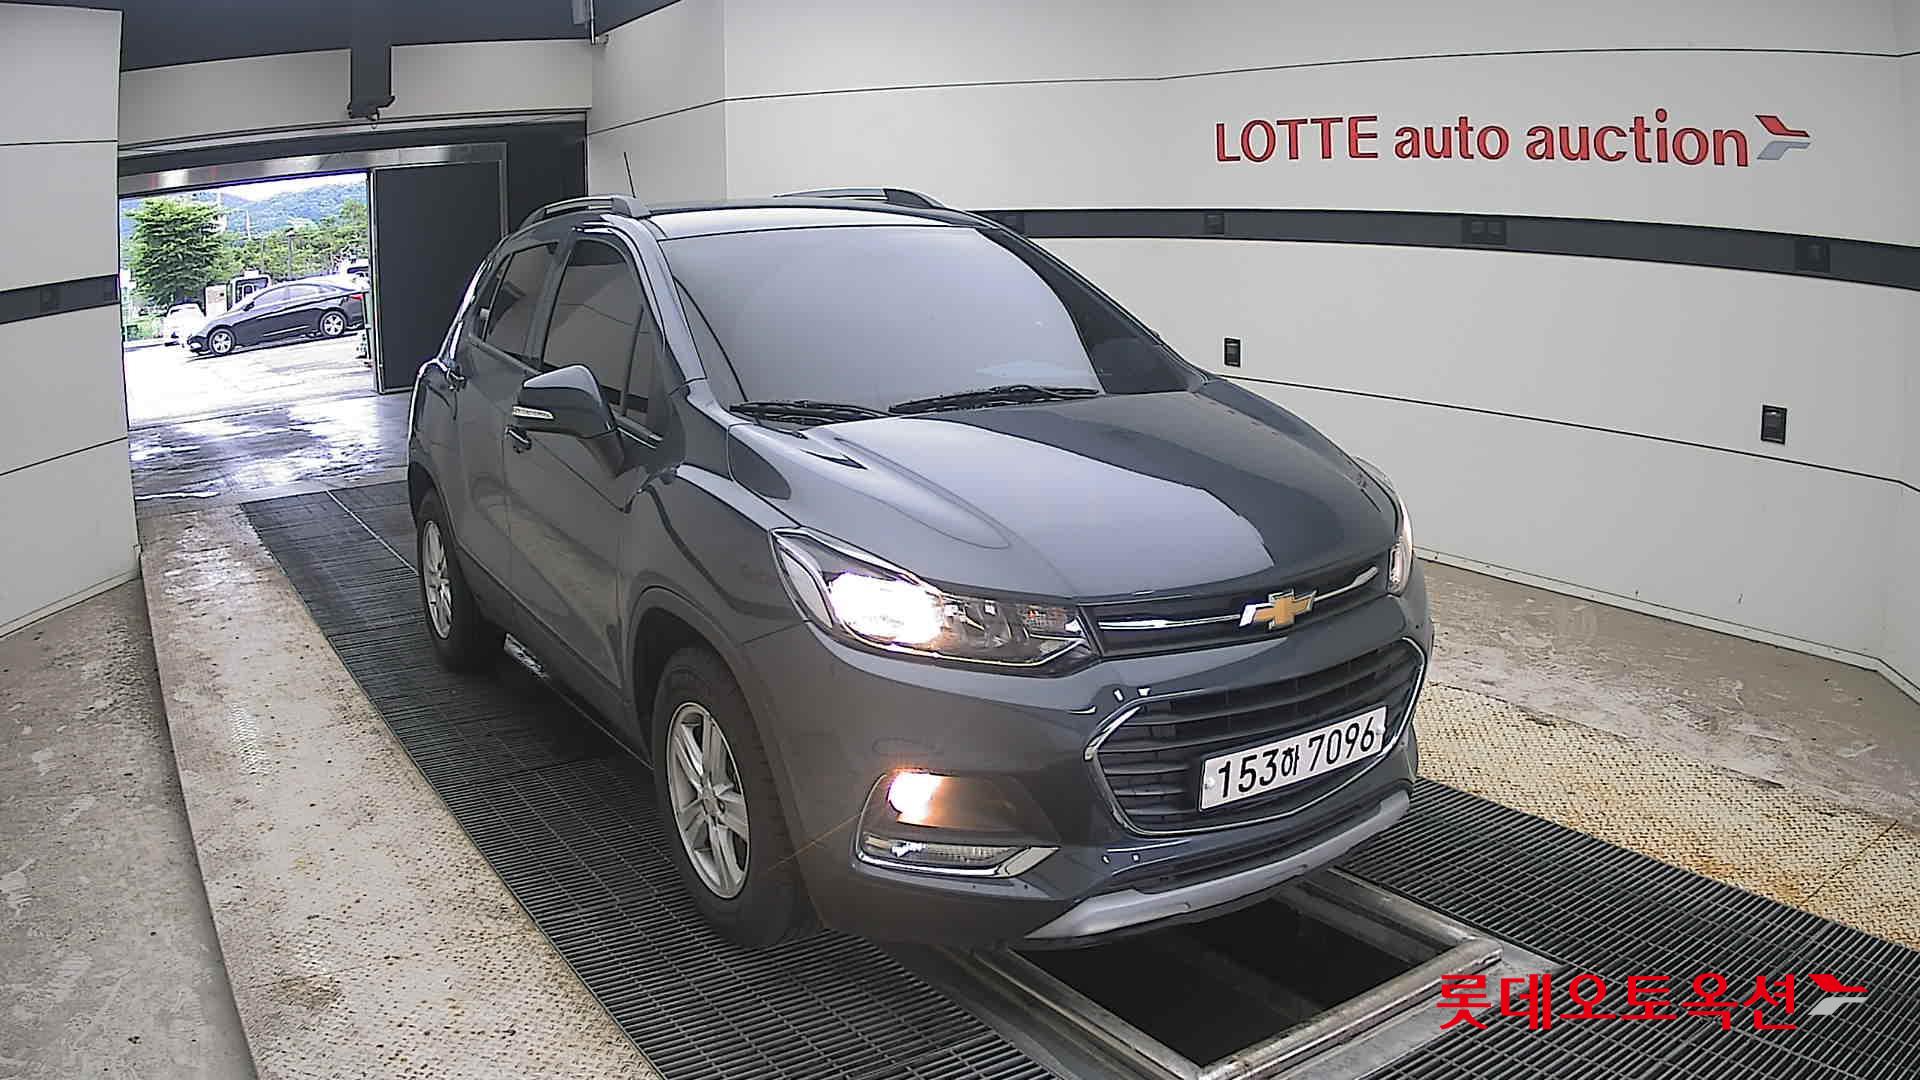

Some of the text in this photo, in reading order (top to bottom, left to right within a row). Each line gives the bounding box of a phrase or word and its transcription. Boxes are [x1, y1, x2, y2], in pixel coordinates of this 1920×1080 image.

[1216, 108, 1750, 168] LOTTE auto auction
[1218, 716, 1375, 798] 153하 7096
